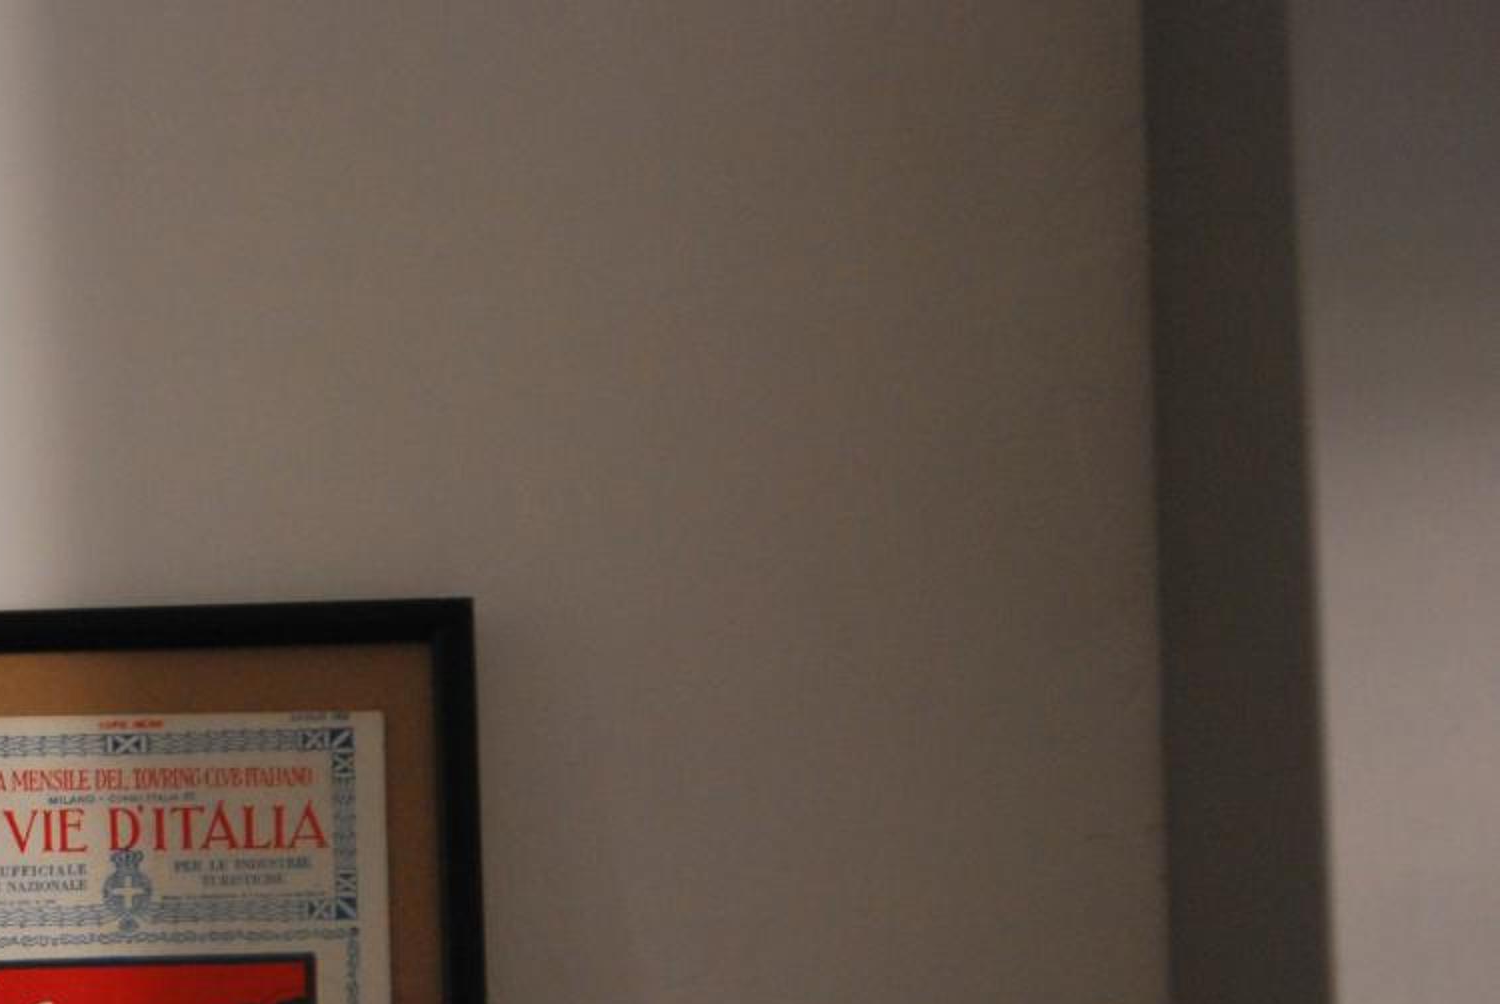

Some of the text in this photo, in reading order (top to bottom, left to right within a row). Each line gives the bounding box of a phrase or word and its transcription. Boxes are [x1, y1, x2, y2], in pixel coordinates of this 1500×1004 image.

[11, 767, 89, 792] MENSILE
[95, 766, 129, 791] DEL
[243, 764, 314, 788] ITALIANO
[48, 794, 96, 805] MILANO
[2, 808, 87, 854] VIE
[108, 799, 328, 854] D'ITALIA
[174, 859, 201, 873] PER
[209, 858, 227, 872] LE
[7, 879, 87, 894] NAZIONALE
